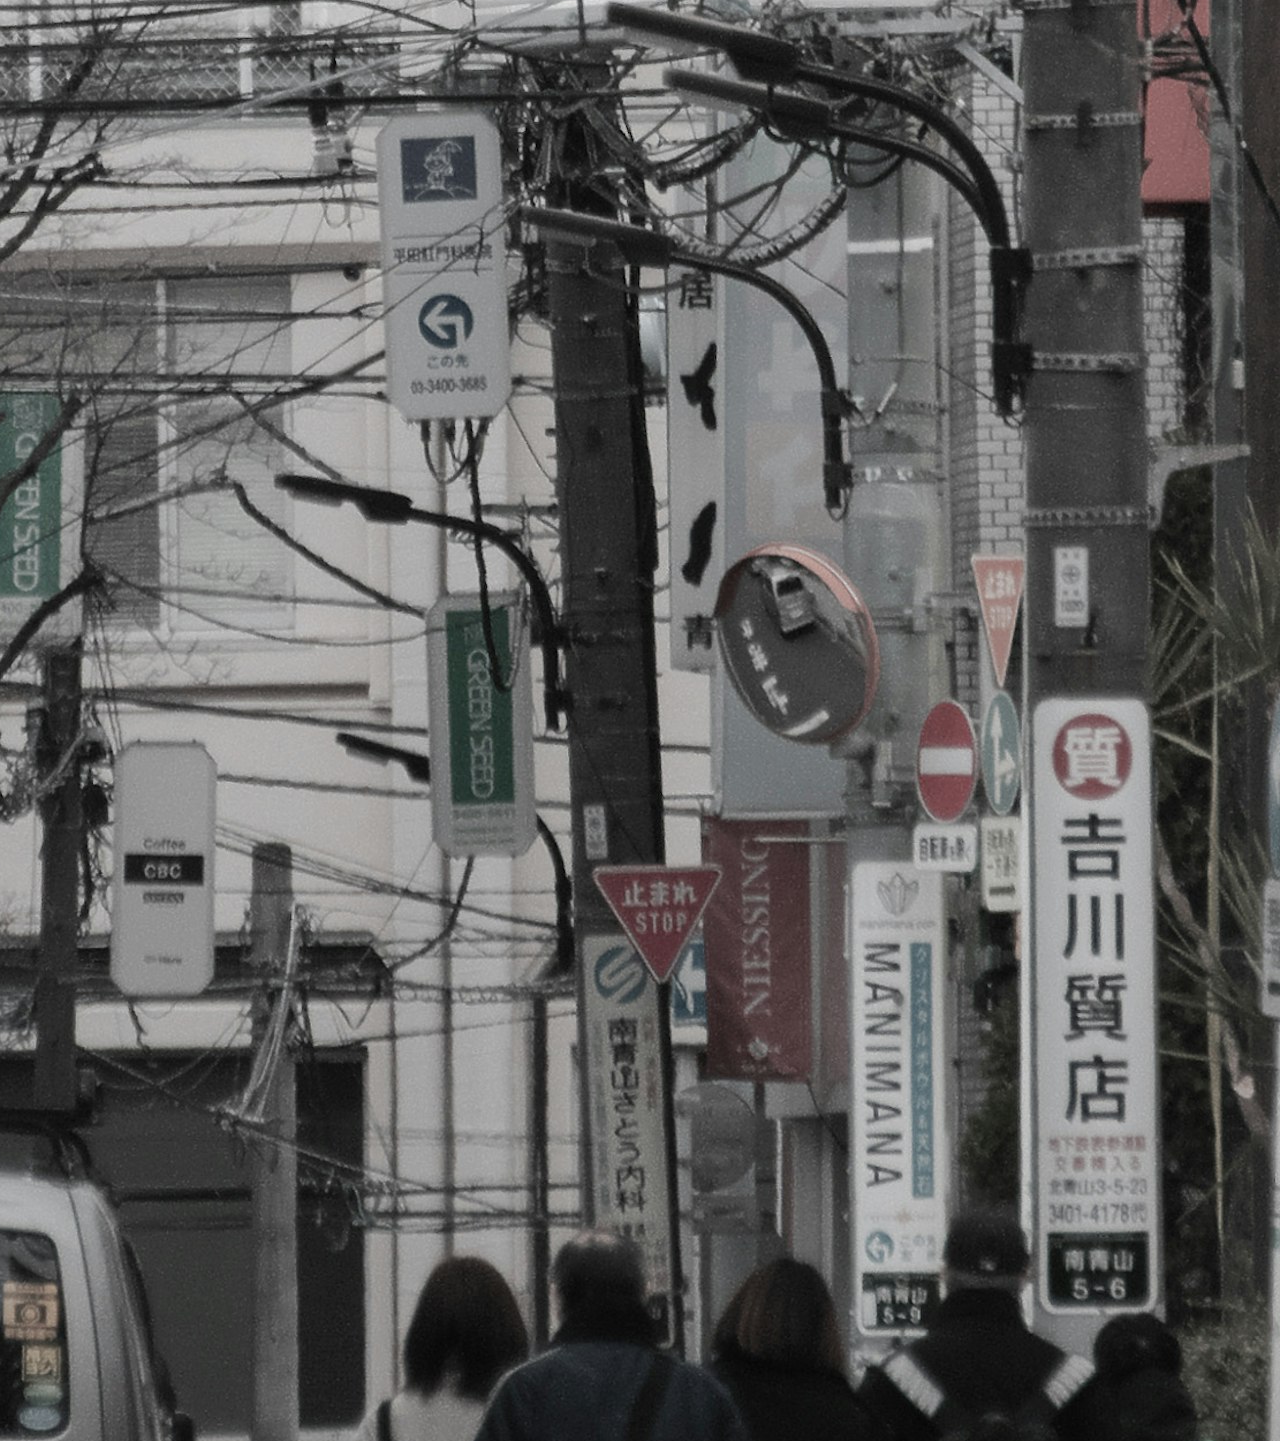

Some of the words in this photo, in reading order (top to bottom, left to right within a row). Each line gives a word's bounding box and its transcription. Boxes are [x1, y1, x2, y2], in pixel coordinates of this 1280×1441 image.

[13, 524, 41, 592] SEED
[467, 648, 492, 732] GREEN
[470, 735, 495, 799] SEED
[1063, 726, 1123, 788] 質
[143, 838, 186, 851] Coffee
[621, 880, 699, 908] 止まれ
[635, 911, 689, 935] STOP
[741, 837, 773, 1016] NIESSING
[863, 943, 904, 1188] MANIMANA
[1064, 1248, 1135, 1273] 南青山
[1072, 1276, 1127, 1301] 5-6
